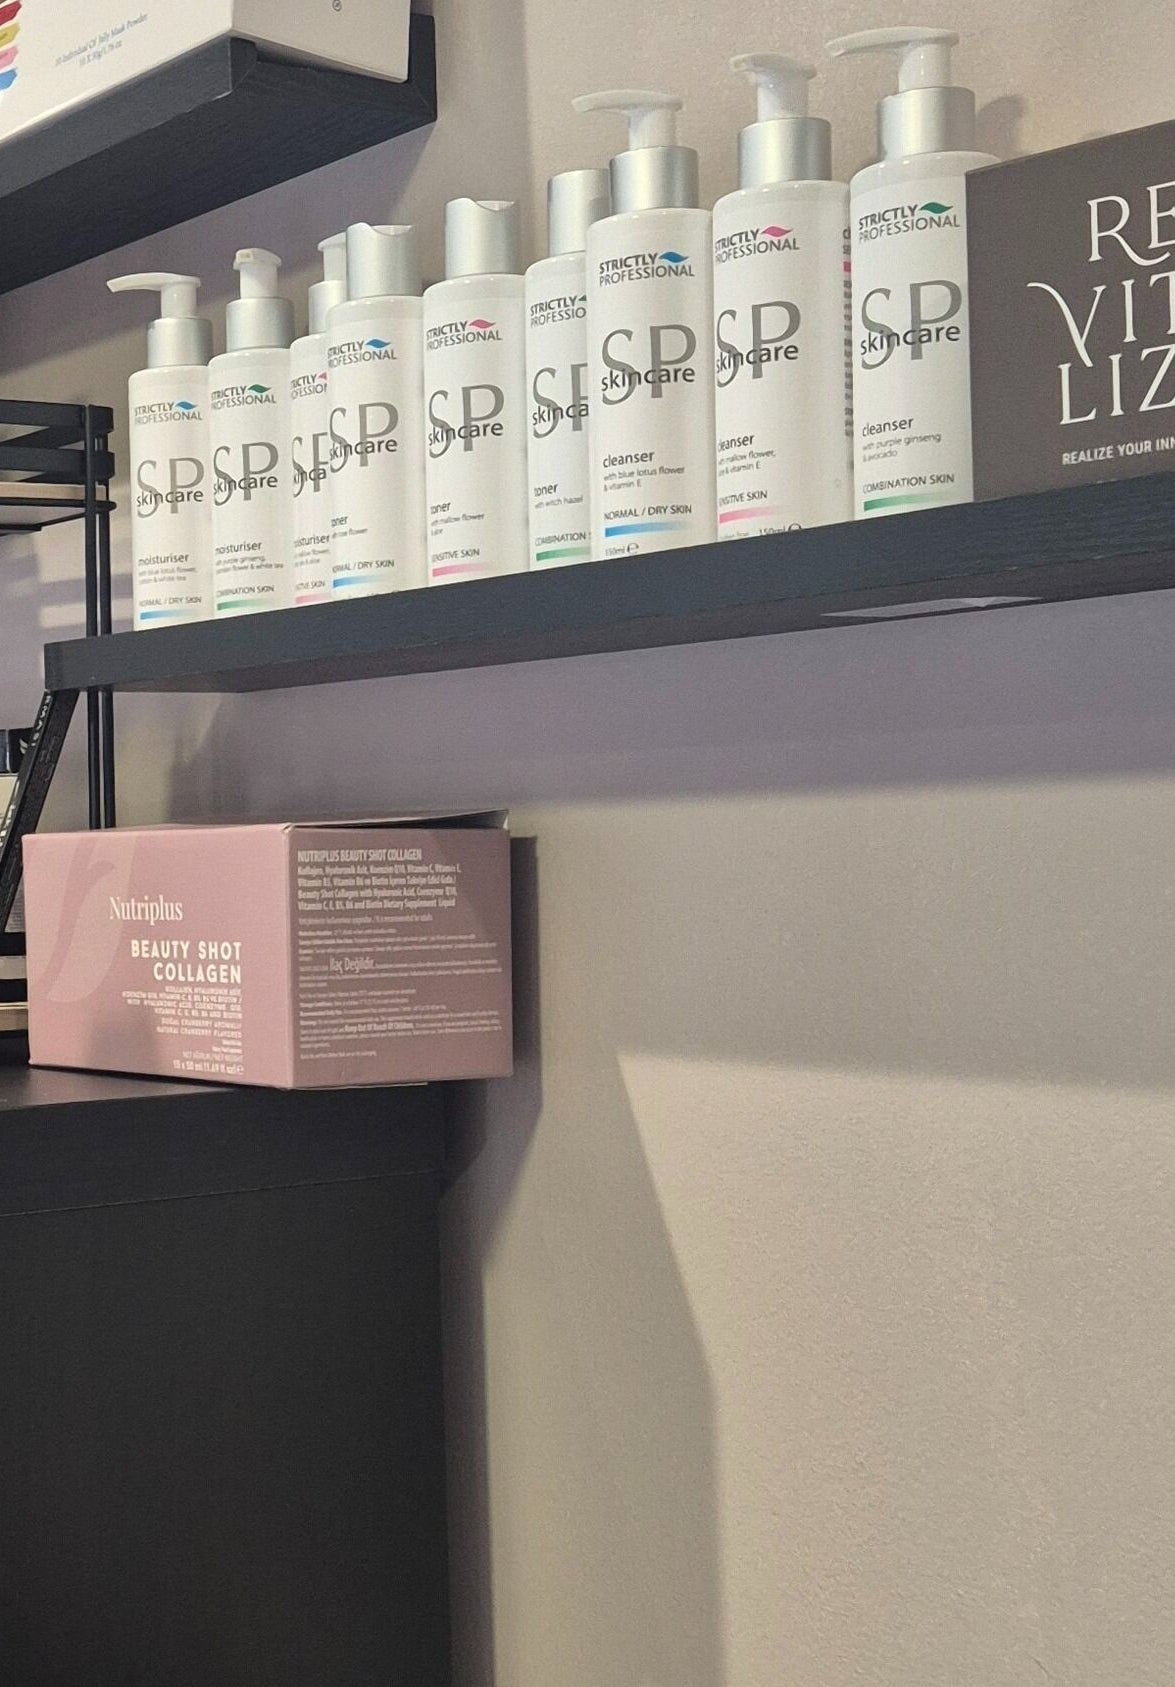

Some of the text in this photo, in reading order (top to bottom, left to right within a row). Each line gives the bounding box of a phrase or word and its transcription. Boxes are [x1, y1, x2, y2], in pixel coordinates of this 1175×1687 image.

[859, 204, 919, 231] STRICTLY
[859, 215, 960, 244] PROFESSIONAL
[715, 229, 760, 254] STRICTLY
[599, 253, 658, 275] STRICTLY
[599, 265, 695, 287] PROFESSIONAL
[530, 296, 578, 317] STRICTLY
[426, 320, 469, 341] STRICTLY
[861, 279, 962, 370] SP
[717, 301, 801, 388] SP
[861, 325, 961, 356] skincare
[328, 350, 398, 368] ROFESSIONAL
[602, 324, 697, 406] SP
[716, 344, 800, 373] skincare
[601, 366, 695, 391] skincare
[211, 394, 277, 410] ROFESSIONAL
[429, 384, 505, 459] SP
[532, 403, 589, 426] skinca
[329, 402, 399, 473] SP
[428, 421, 504, 447] skincare
[862, 418, 914, 437] cleanser
[329, 439, 398, 460] skincare
[719, 434, 755, 452] leanser
[1062, 445, 1114, 465] REALIZE
[1116, 440, 1152, 457] YOUR
[603, 450, 655, 468] cleanser
[213, 442, 279, 507] SP
[618, 471, 635, 479] blue
[637, 468, 657, 477] lotus
[659, 466, 685, 475] flower
[863, 473, 955, 493] COMBINATION SKIN
[137, 458, 204, 518] SP
[213, 475, 279, 495] skincare
[137, 490, 204, 507] skincare
[747, 491, 768, 502] SKIN
[604, 508, 637, 521] NORMAL
[648, 506, 668, 517] DRY
[670, 504, 693, 515] SKIN
[460, 548, 480, 558] SKIN
[357, 561, 373, 570] DRY
[376, 559, 395, 568] SKIN
[298, 849, 339, 862] NUTRIPLUS
[340, 849, 367, 862] BEAUTY
[387, 848, 422, 861] COLLAGEN
[109, 894, 184, 926] Nutriplus
[131, 939, 243, 961] BEAUTY SHOT
[153, 962, 242, 984] COLLAGEN
